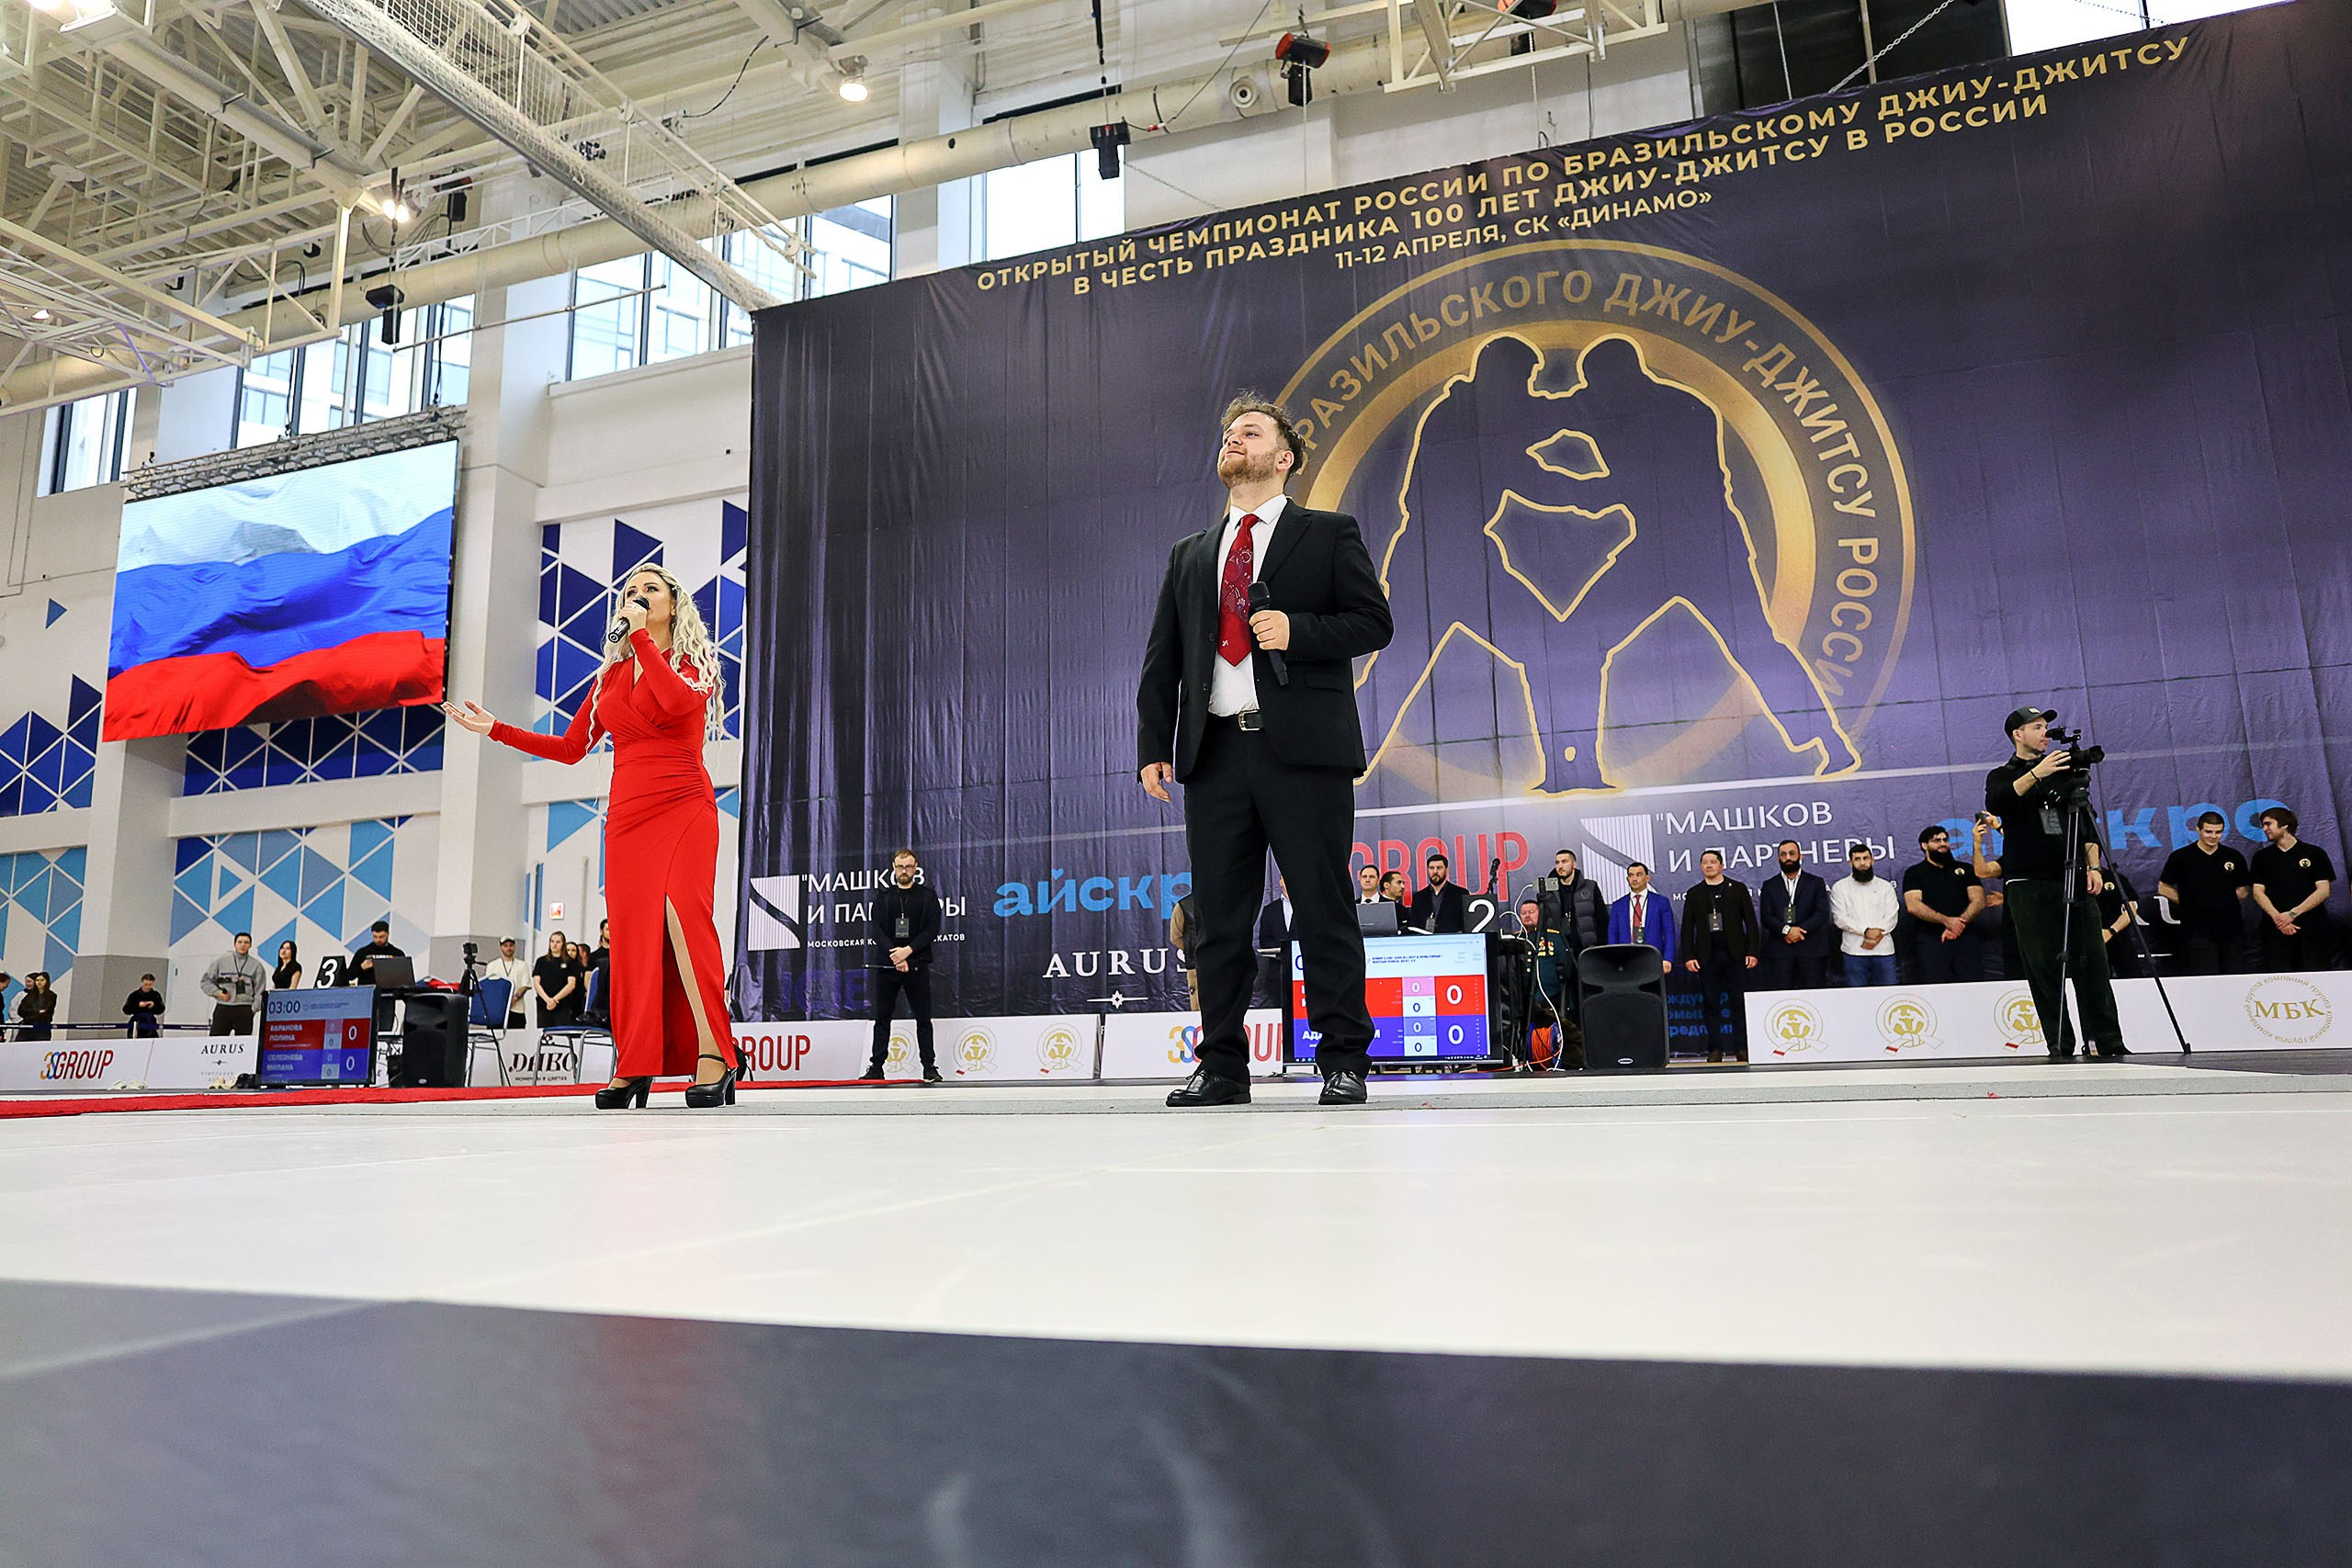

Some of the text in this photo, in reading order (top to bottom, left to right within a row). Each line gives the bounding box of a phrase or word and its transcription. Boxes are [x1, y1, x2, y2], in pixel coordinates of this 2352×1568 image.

[978, 37, 2188, 290] ОТКРЫТЫЙ ЧЕМПИОНАТ РОССИИ ПО БРАЗИЛЬСКОМУ ДЖИУ-ДЖИТСУ
[1074, 95, 2048, 295] В ЧЕСТЬ ПРАЗДНИКА 100 ЛЕТ ДЖИУ-ДЖИТСУ В РОССИИ
[1335, 189, 1713, 268] 11-12 АПРЕЛЯ, СК «ДИНАМО»
[1603, 273, 1877, 518] ДЖИУ-ДЖИТСУ
[1669, 850, 1691, 873] И
[808, 904, 824, 924] И
[1468, 898, 1495, 932] 2
[808, 939, 865, 948] МОСКОВСКАЯ
[316, 958, 338, 989] 3
[1446, 985, 1463, 1005] 0
[268, 1000, 300, 1014] 03:00
[1413, 1002, 1420, 1012] 0
[2254, 999, 2326, 1020] МБК
[349, 1025, 357, 1041] 0
[1448, 1024, 1464, 1044] 0
[201, 1043, 244, 1055] AURUS
[1414, 1043, 1422, 1052] 0
[346, 1055, 355, 1070] 0
